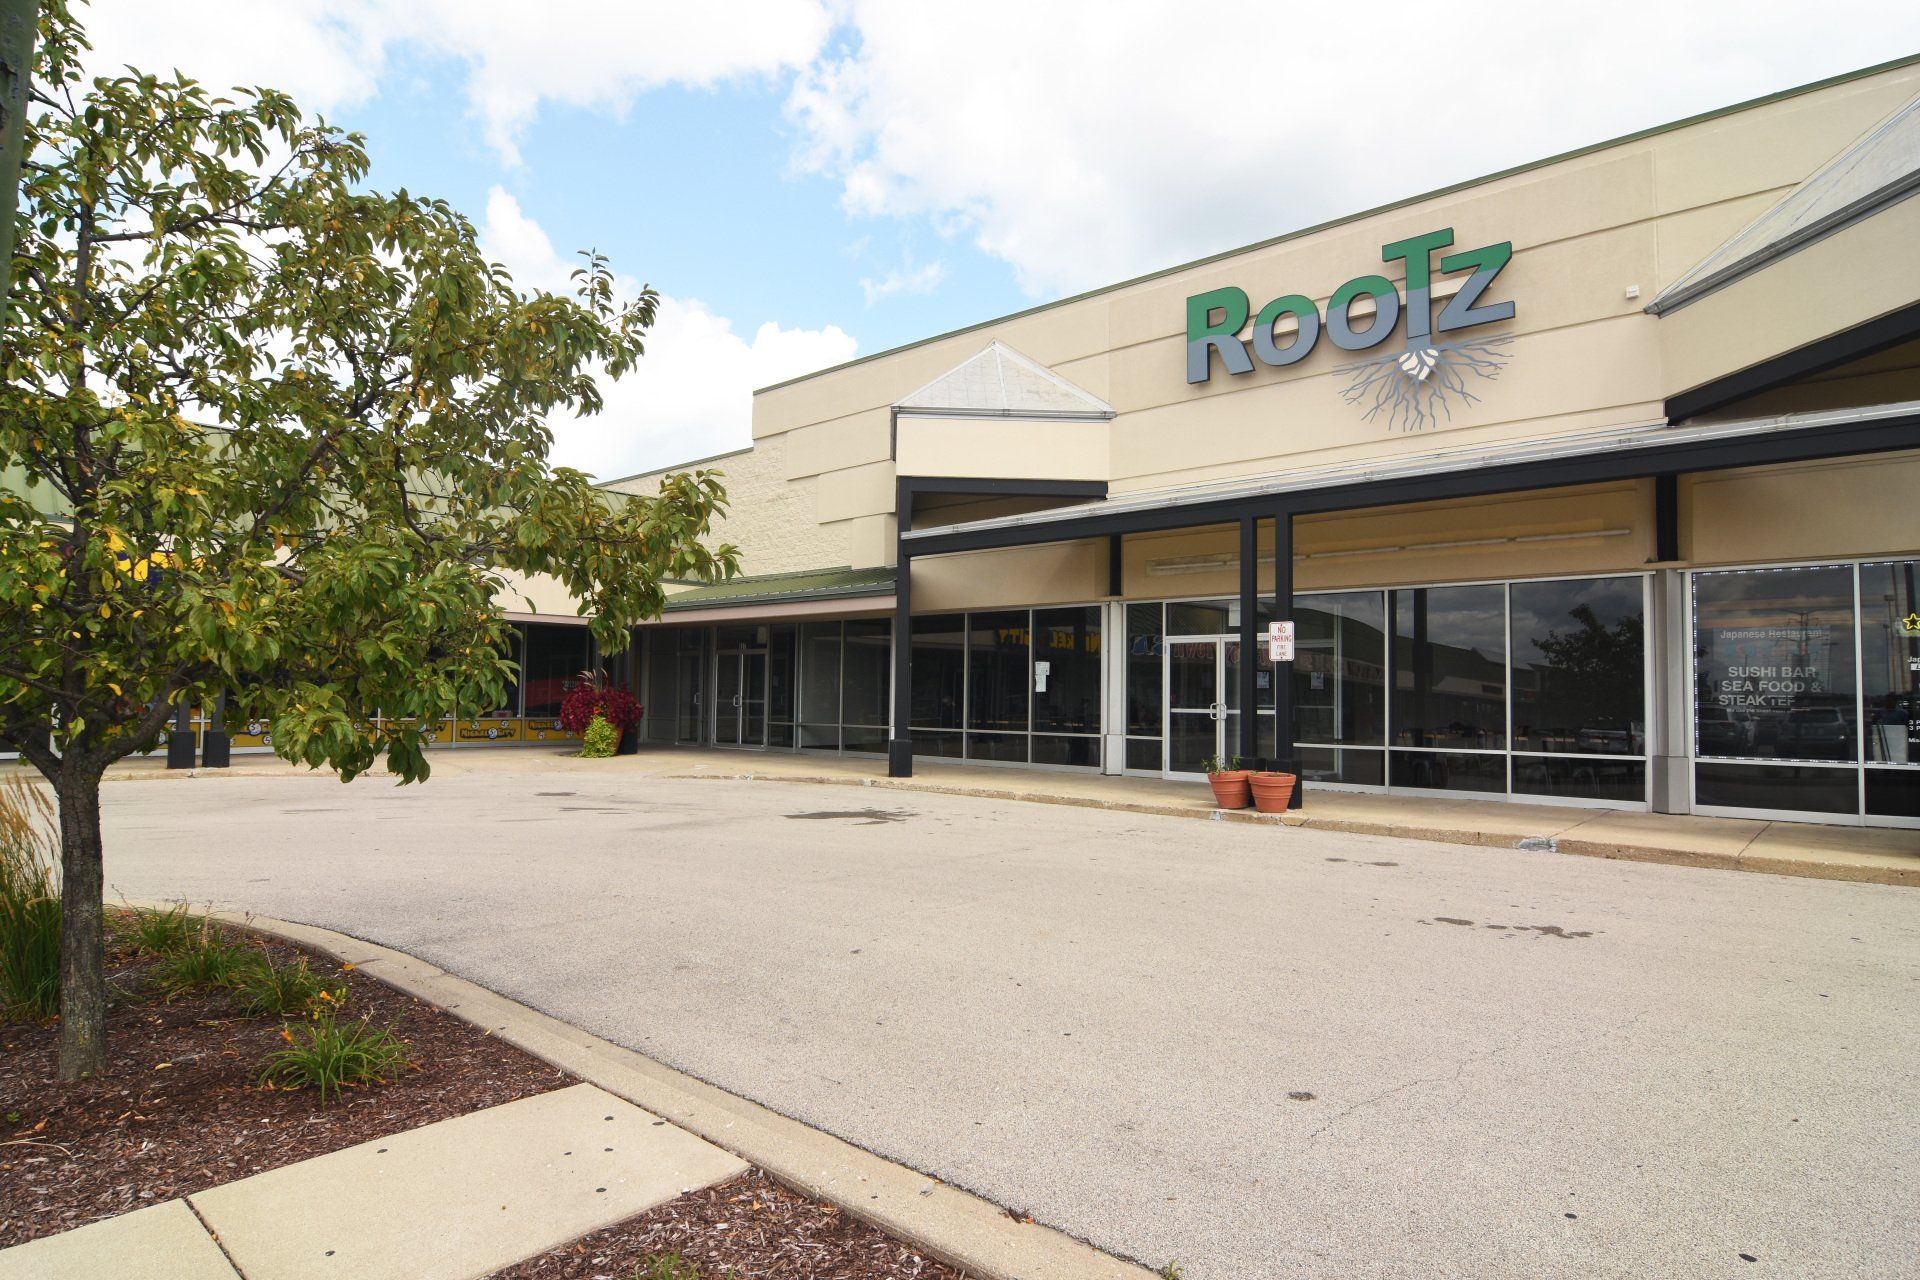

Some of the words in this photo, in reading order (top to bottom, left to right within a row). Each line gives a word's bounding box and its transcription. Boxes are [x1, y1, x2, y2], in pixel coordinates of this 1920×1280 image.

[1277, 626, 1286, 634] NO
[1720, 630, 1765, 640] Japanese
[1728, 666, 1776, 677] SUSHI
[1781, 666, 1816, 678] BAR
[1721, 681, 1754, 692] SEA
[1758, 681, 1805, 692] FOOD
[1810, 681, 1822, 693] &
[1718, 695, 1766, 706] STEAK
